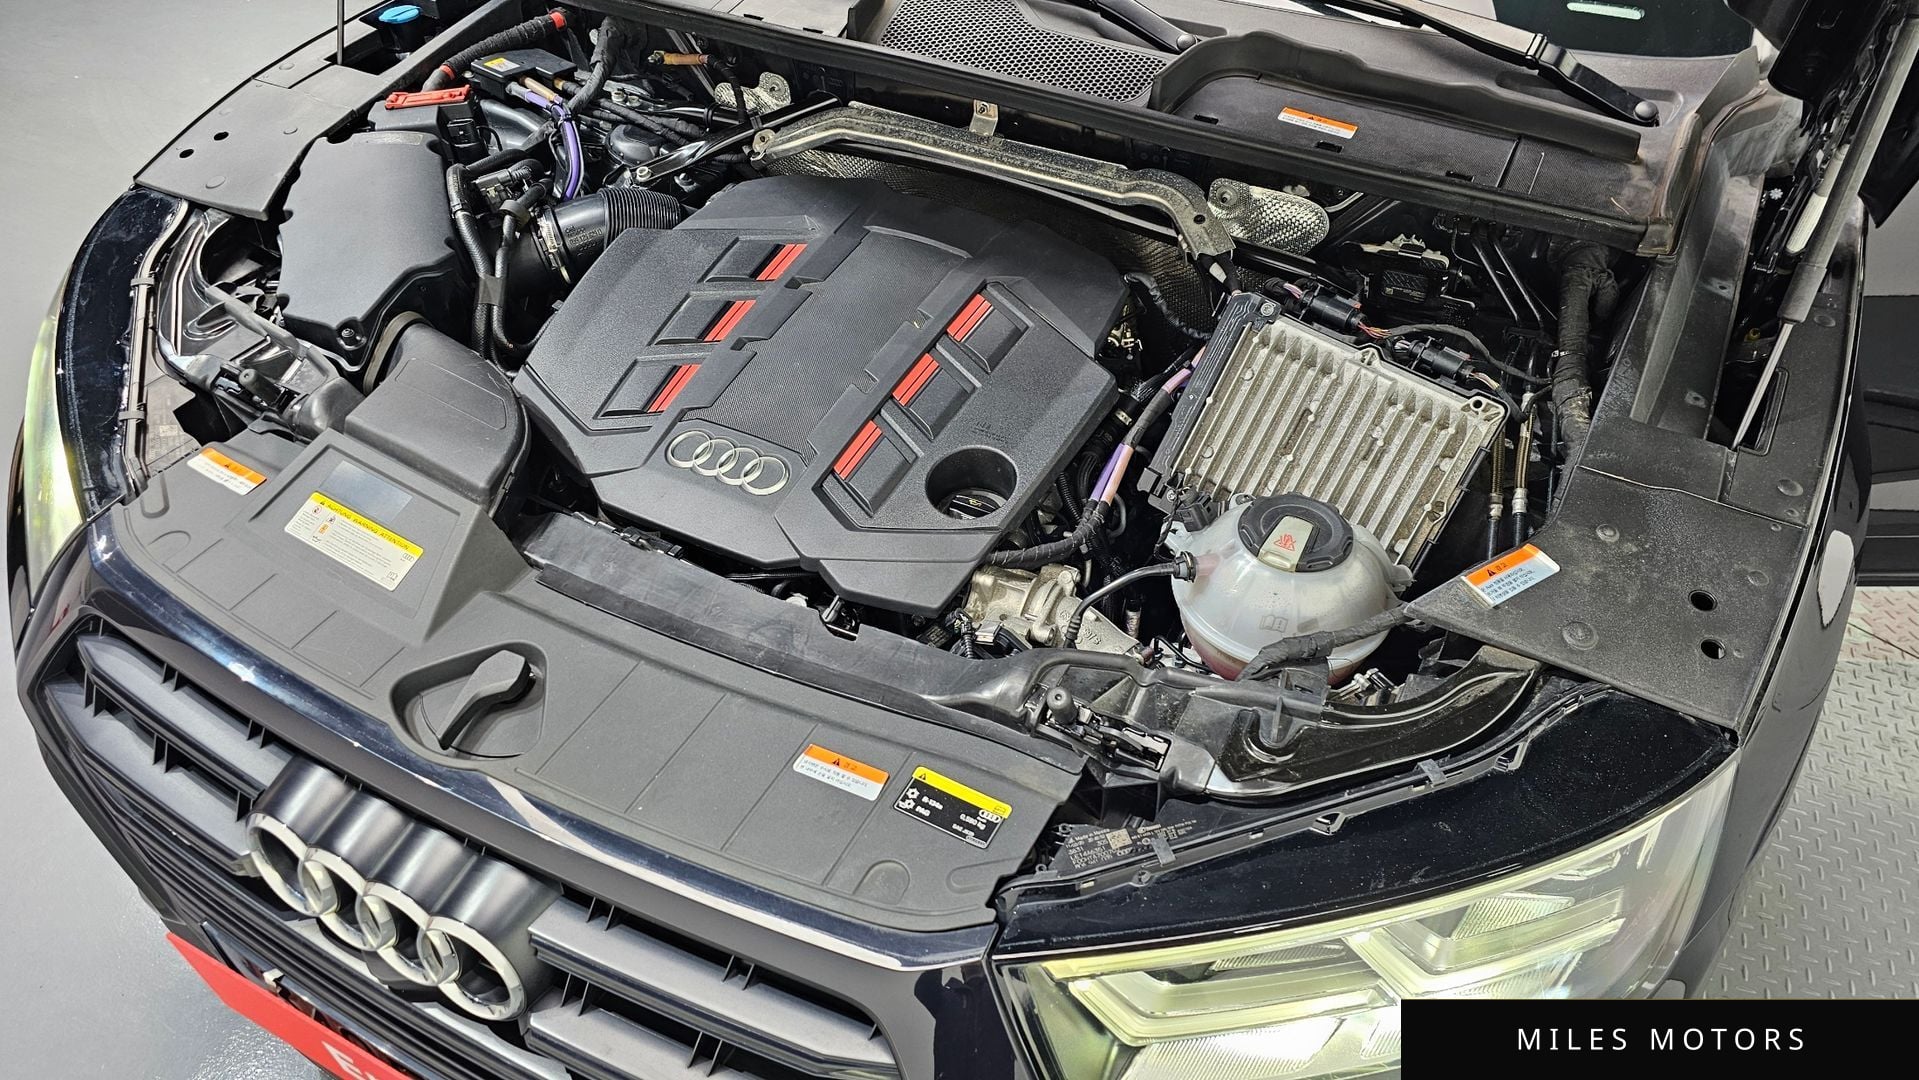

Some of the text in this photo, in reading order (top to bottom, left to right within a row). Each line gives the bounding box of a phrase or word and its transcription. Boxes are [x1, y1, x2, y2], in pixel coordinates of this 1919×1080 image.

[327, 503, 410, 551] ACHTUNG WARNING ATTENTION
